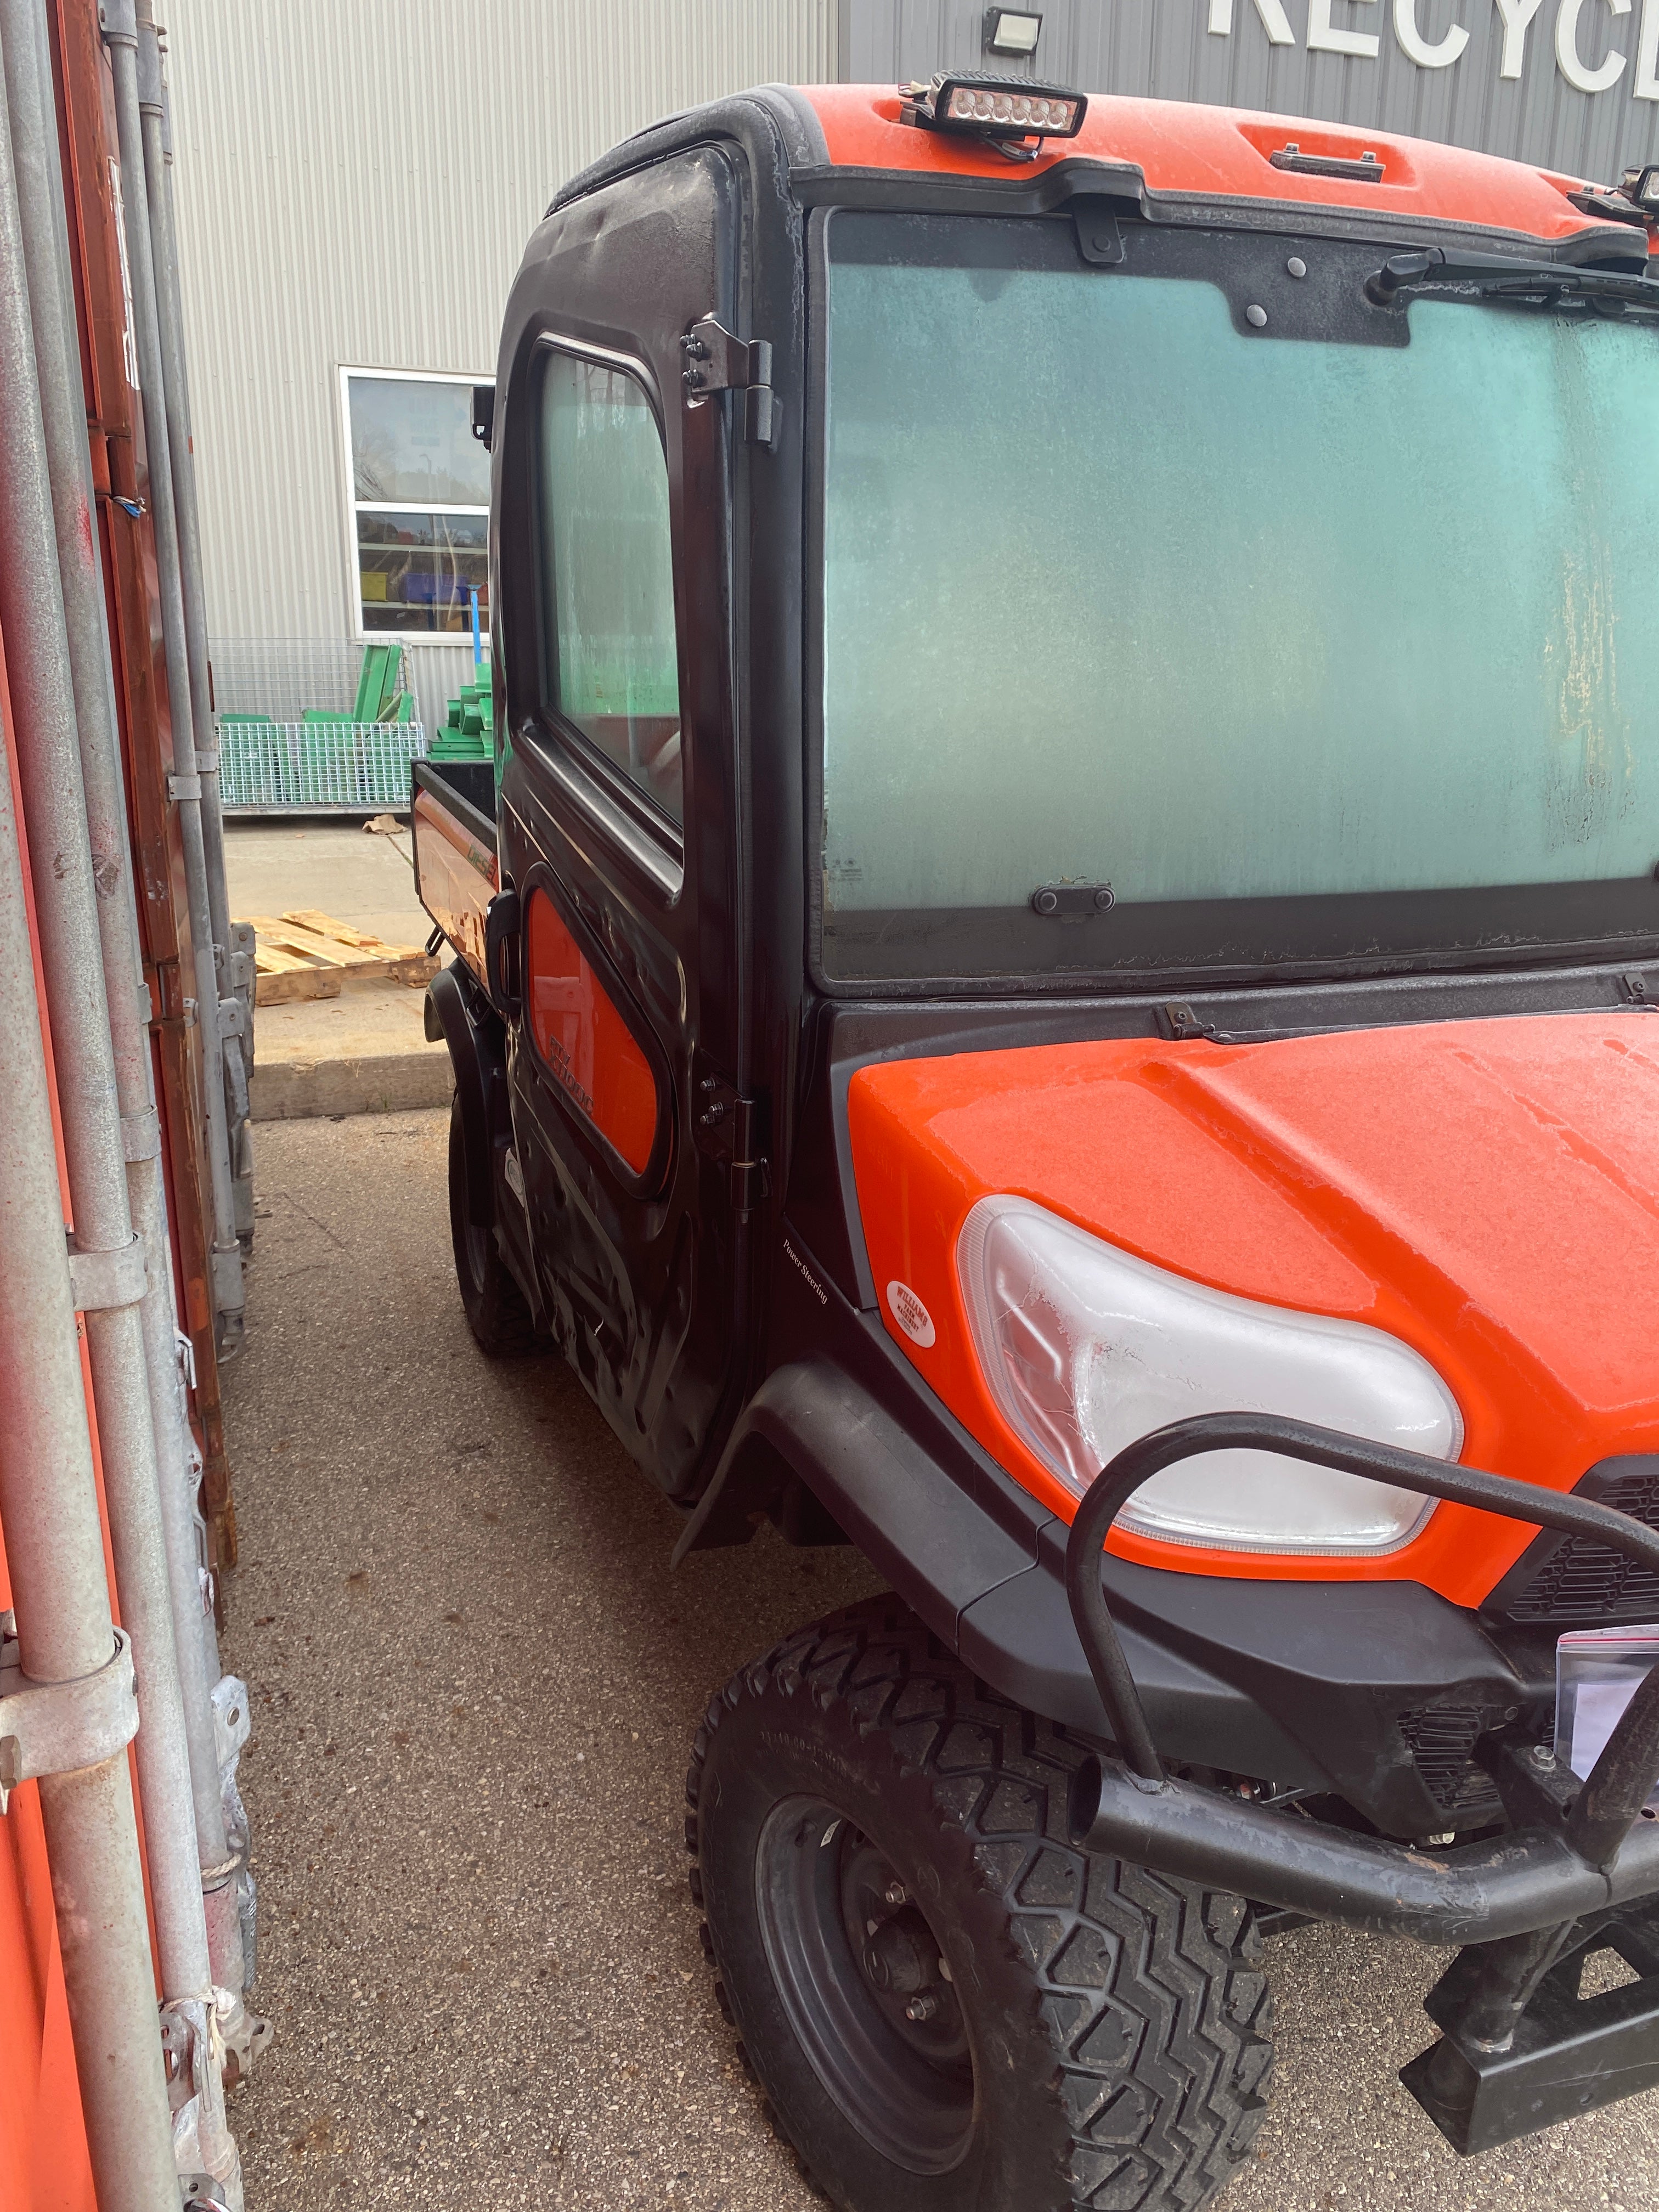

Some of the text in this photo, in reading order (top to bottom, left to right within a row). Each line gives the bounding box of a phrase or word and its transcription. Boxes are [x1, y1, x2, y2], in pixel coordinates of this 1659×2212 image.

[467, 845, 496, 887] DIESEL
[783, 1239, 827, 1305] Power Steering
[896, 1285, 928, 1327] WILLIAMS
